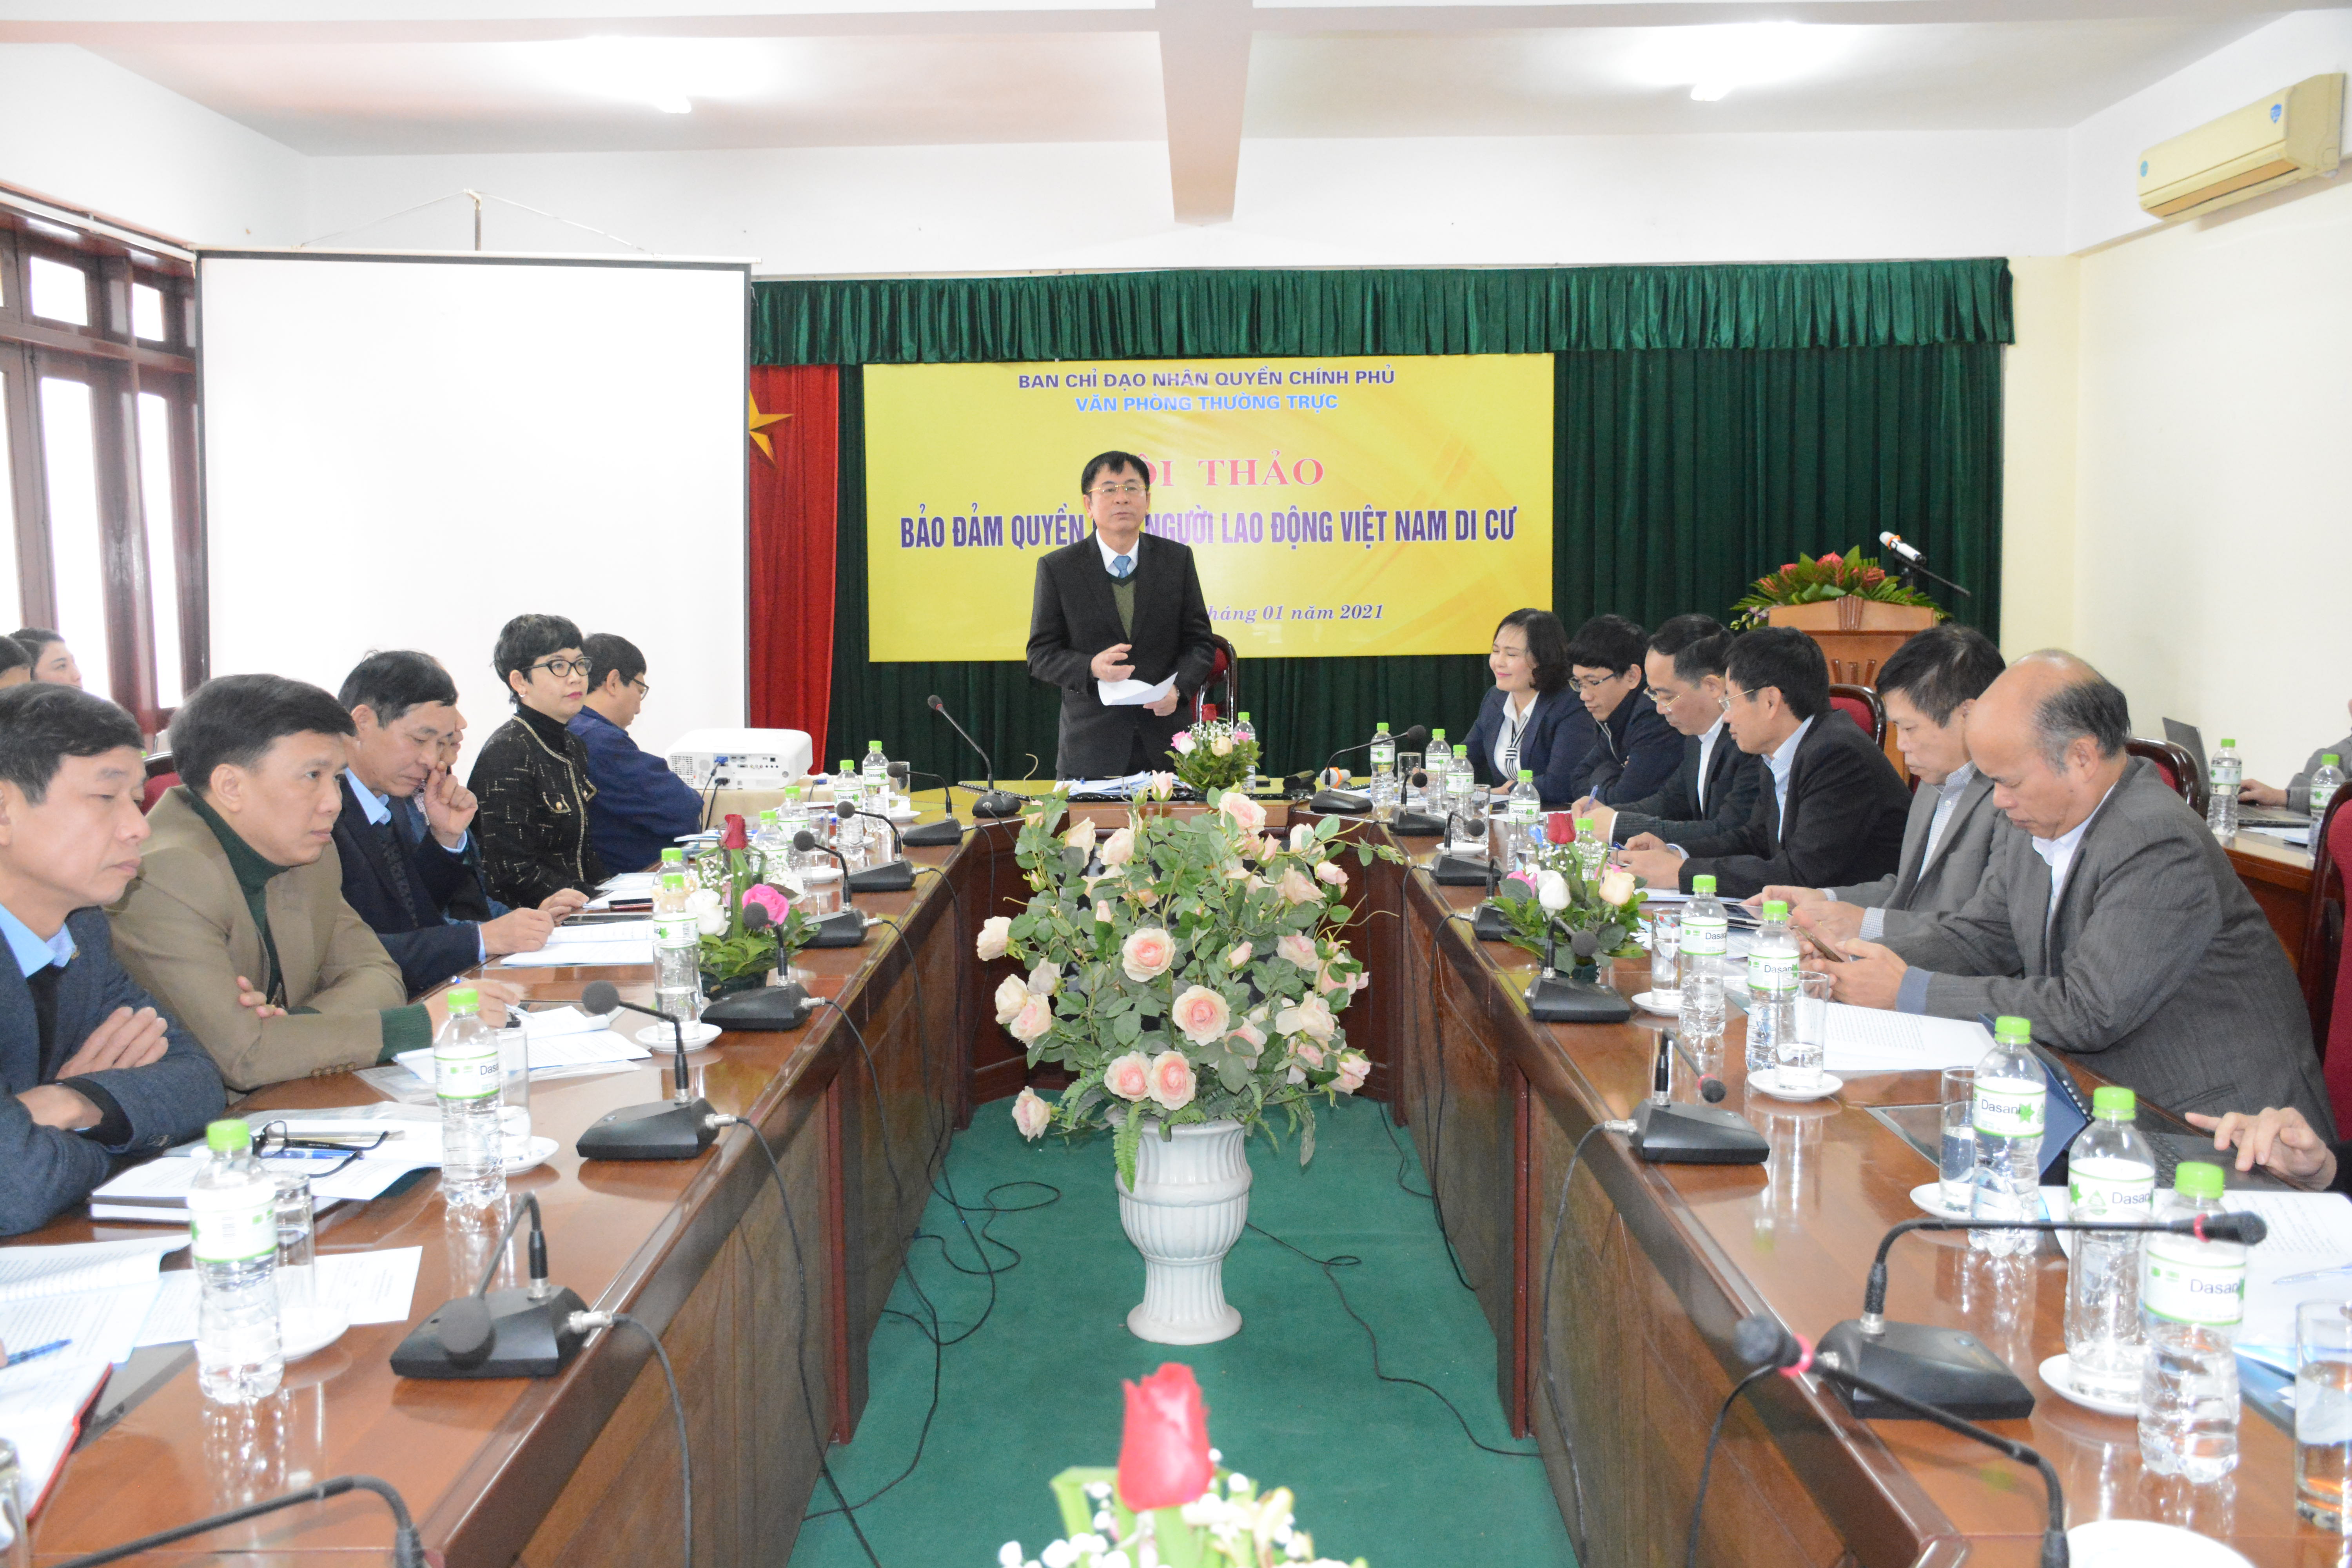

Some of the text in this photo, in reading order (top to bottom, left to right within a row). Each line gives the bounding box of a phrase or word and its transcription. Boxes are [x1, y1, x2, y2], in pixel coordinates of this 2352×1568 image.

[1019, 364, 1394, 391] BAN CHỈ ĐẠO NHÂN QUYỀN CHÍNH PHỦ
[1075, 392, 1338, 413] VĂN PHÒNG THƯỜNG TRỰC
[1198, 450, 1324, 486] THẢO
[901, 503, 945, 548] BẢO
[952, 502, 1003, 547] ĐẢM
[1011, 503, 1084, 550] QUYỀN
[1222, 512, 1263, 544] LAO
[1271, 505, 1332, 549] ĐỘNG
[1340, 504, 1387, 548] VIỆT
[1395, 510, 1447, 542] NAM
[1455, 510, 1477, 541] DI
[1485, 506, 1517, 541] CƯ
[1208, 604, 1383, 623] háng 01 năm 2021
[480, 1063, 499, 1076] Dasa
